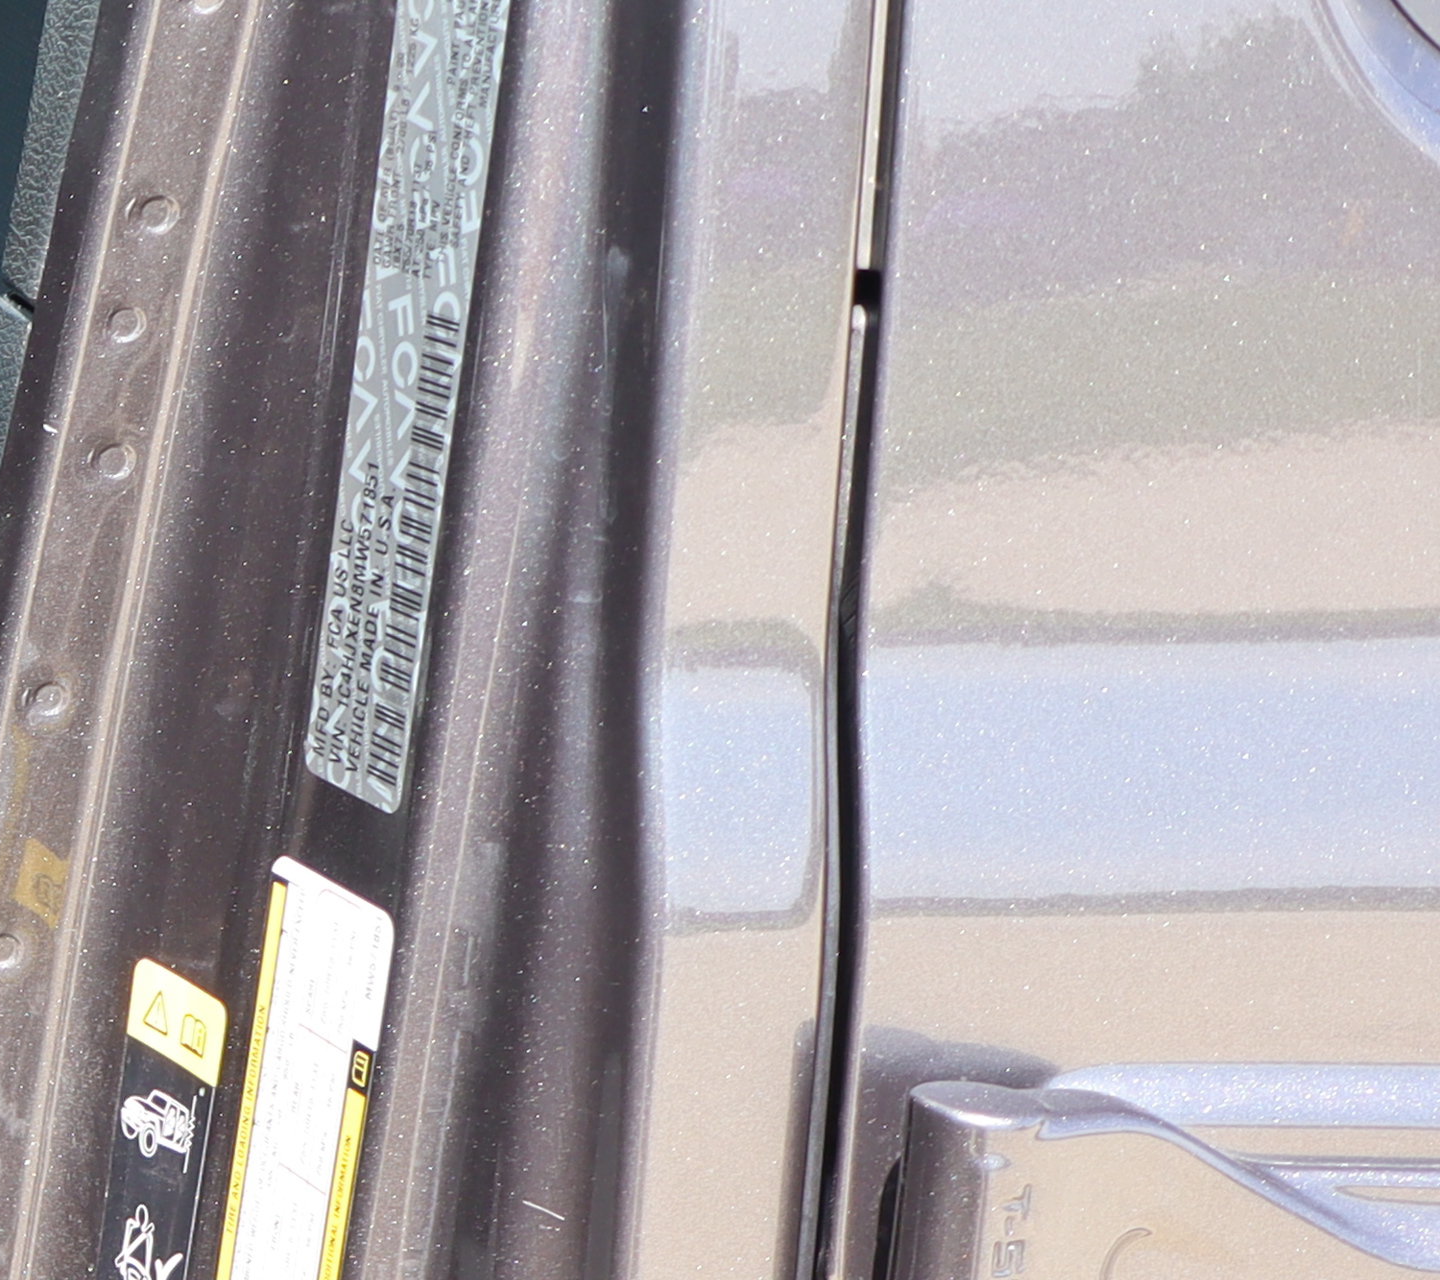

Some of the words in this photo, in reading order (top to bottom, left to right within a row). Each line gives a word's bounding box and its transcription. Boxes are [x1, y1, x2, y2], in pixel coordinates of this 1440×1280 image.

[463, 19, 476, 48] ALL
[468, 0, 490, 96] PREVENTION
[460, 51, 472, 71] TO
[381, 222, 395, 269] GAWR
[409, 16, 420, 36] KG
[449, 76, 469, 161] CONFORMS
[461, 102, 477, 149] THEFT
[440, 165, 458, 227] VEHICLE
[457, 153, 470, 188] AND
[376, 203, 388, 223] OF
[449, 190, 465, 249] SAFETY
[410, 258, 421, 278] AT
[335, 515, 353, 560] LLC
[371, 481, 395, 556] U.S.A.
[330, 563, 347, 599] US
[366, 561, 385, 598] IN:
[324, 604, 342, 650] FCA
[357, 603, 379, 673] MADE
[319, 658, 336, 700] BY:
[312, 704, 331, 758] MFD
[328, 715, 348, 768] VIN:
[344, 676, 370, 777] VEHICLE
[244, 1001, 267, 1102] INFORMATION
[234, 1103, 252, 1168] LOADING
[230, 1168, 242, 1202] AND
[331, 1130, 352, 1221] INFORMATION
